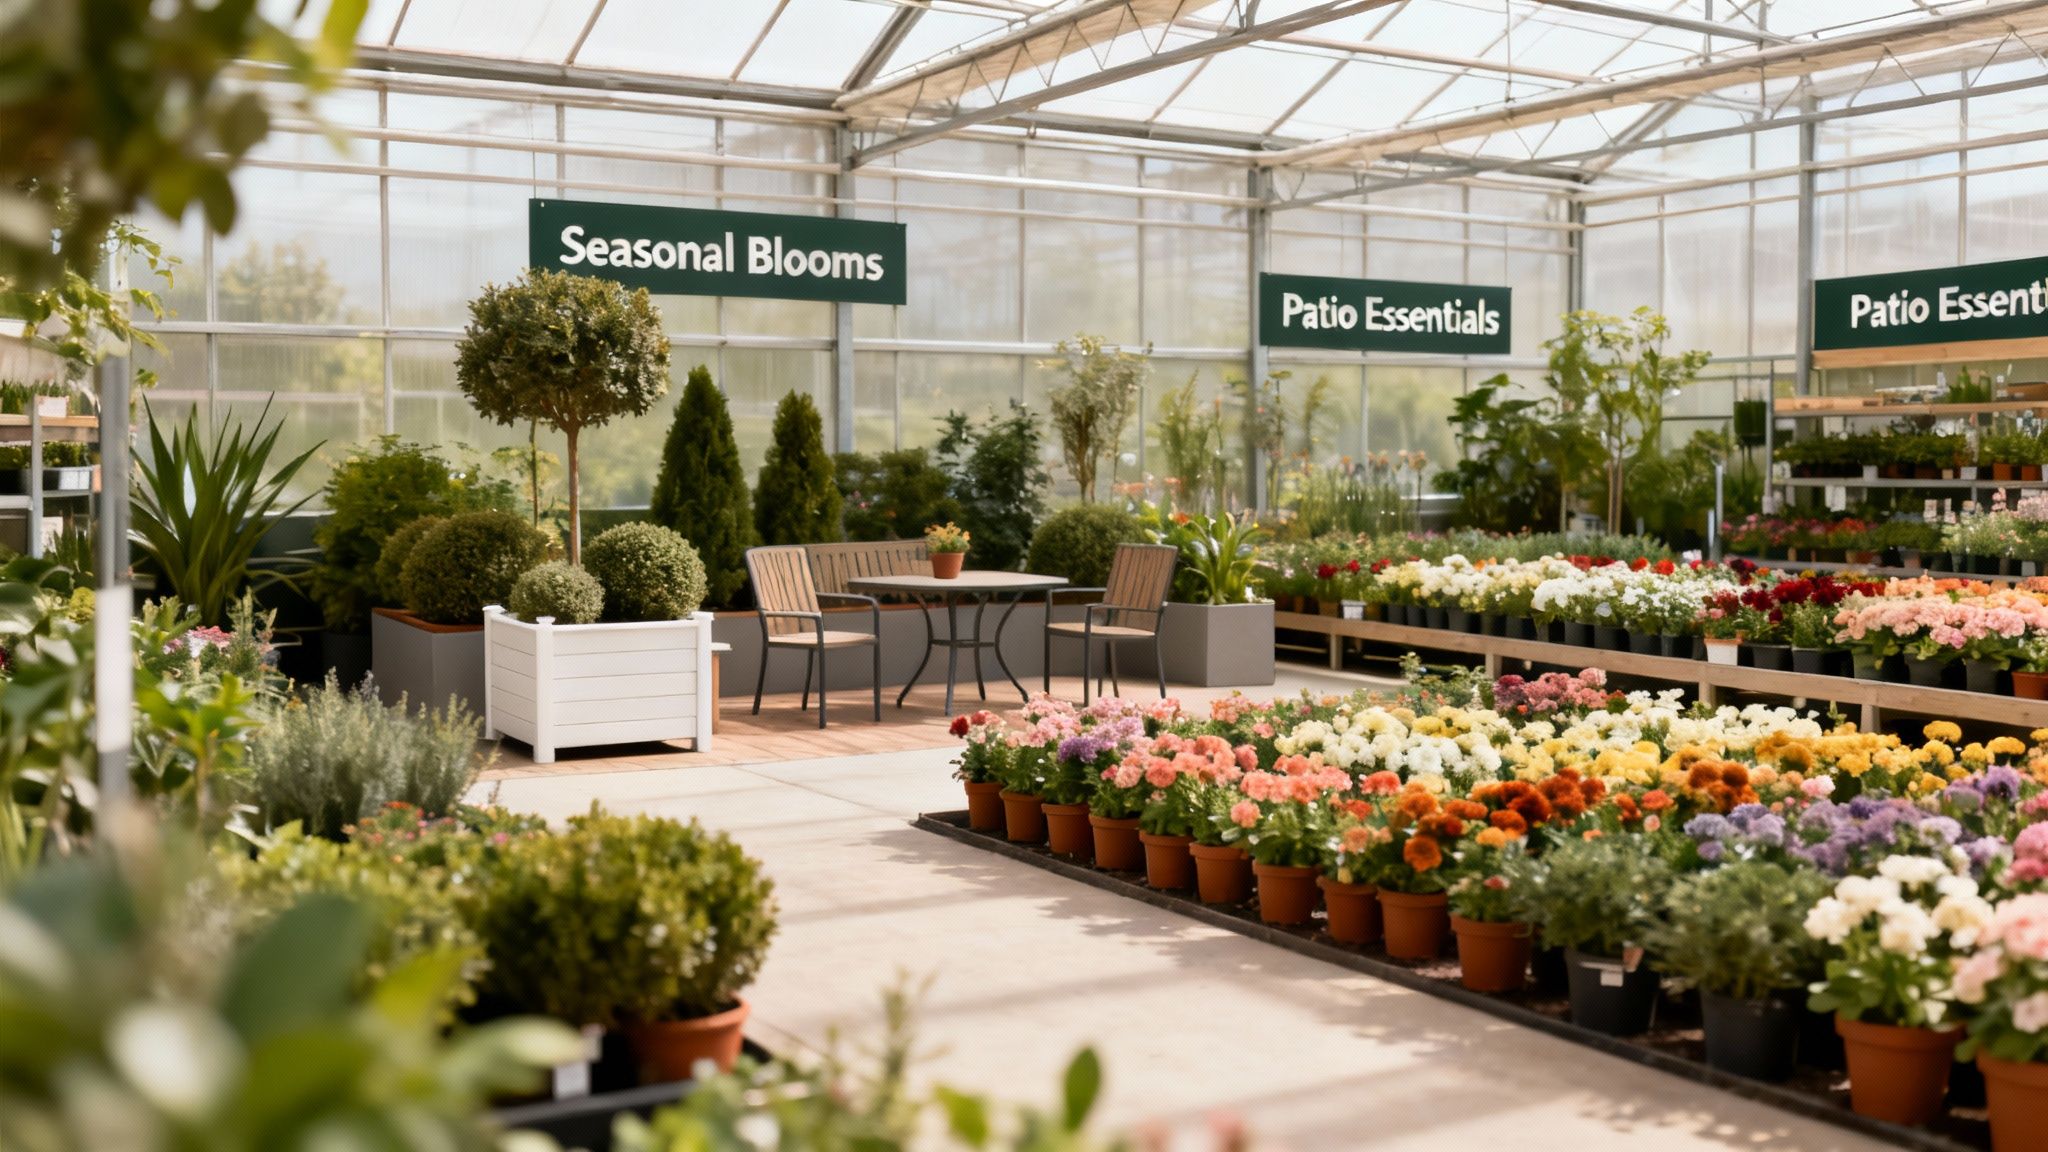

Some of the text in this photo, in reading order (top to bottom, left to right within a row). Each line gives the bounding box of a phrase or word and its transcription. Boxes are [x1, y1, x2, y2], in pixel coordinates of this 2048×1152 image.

[559, 225, 885, 282] Seasonal Blooms
[1282, 292, 1501, 336] Patio Essentials
[1850, 289, 1930, 329] Patio
